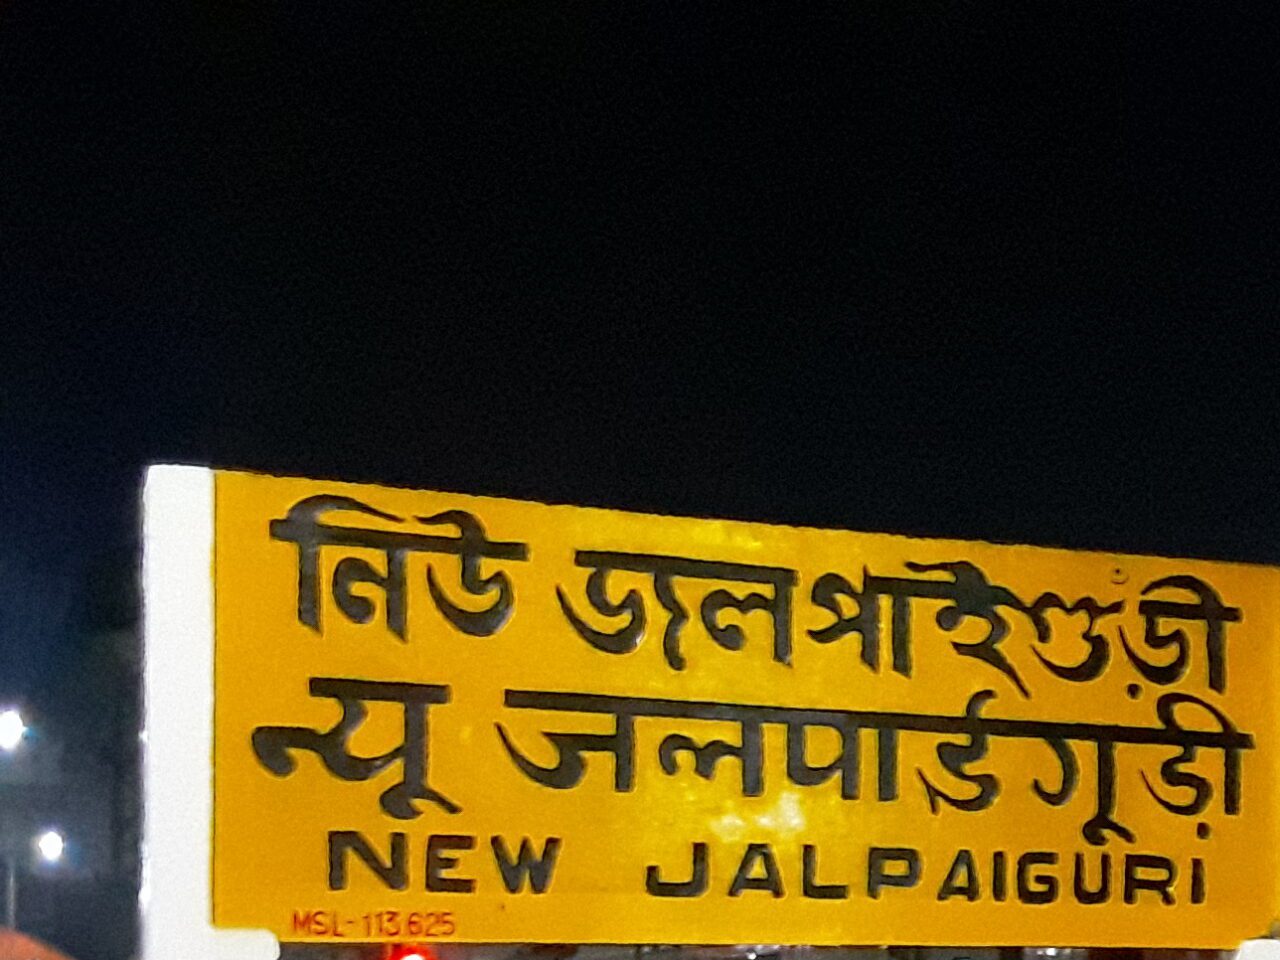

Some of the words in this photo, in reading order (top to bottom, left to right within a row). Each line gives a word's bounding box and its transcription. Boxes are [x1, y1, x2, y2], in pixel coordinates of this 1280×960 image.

[269, 493, 528, 644] নিউ
[251, 677, 462, 819] न्यू
[327, 831, 562, 894] NEW
[645, 842, 1206, 905] JALPAIGURI
